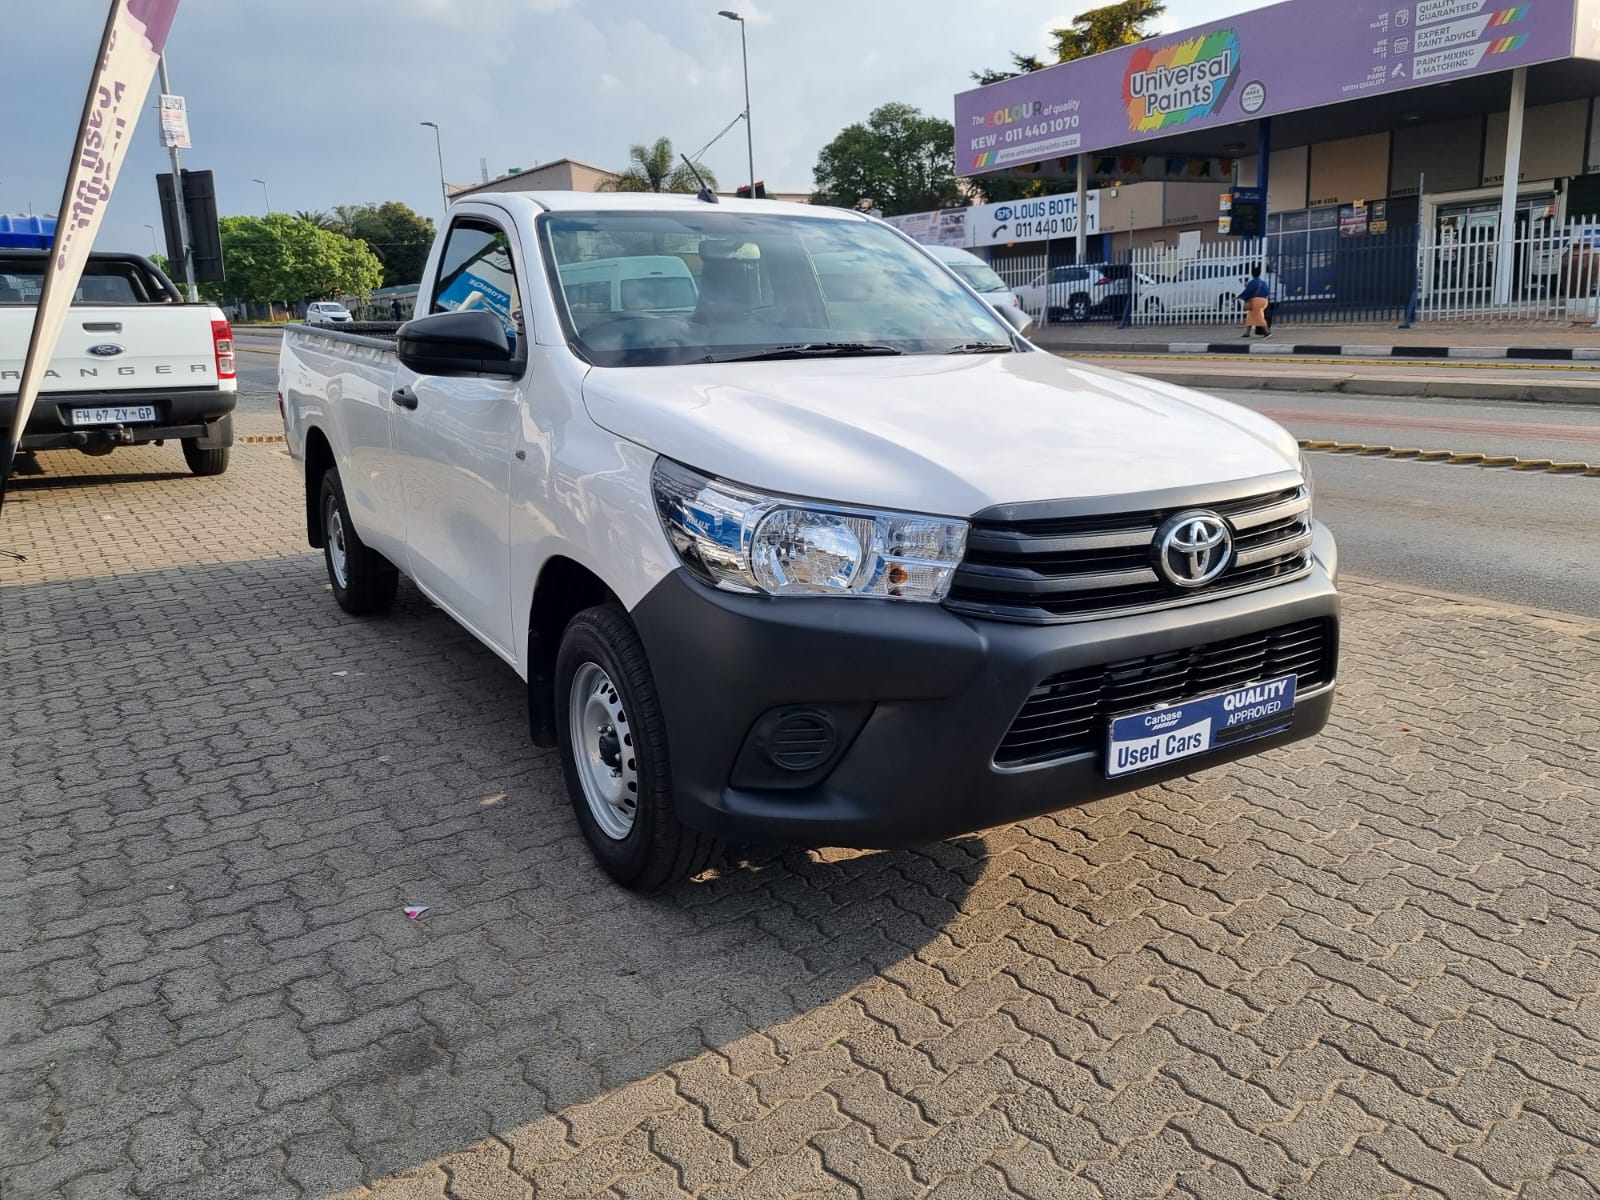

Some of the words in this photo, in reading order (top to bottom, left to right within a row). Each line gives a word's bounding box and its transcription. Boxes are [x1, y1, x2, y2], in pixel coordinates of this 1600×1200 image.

[1418, 1, 1479, 22] GUARANTEED
[1419, 0, 1456, 13] QUALITY
[1417, 26, 1451, 40] EXPERT
[1417, 37, 1444, 48] PAINT
[1444, 29, 1477, 42] ADVICE
[1416, 55, 1442, 66] PAINT
[1443, 48, 1475, 60] MIXING
[1423, 59, 1469, 75] MATCHING
[1131, 52, 1229, 96] Universal
[1147, 83, 1212, 115] Paints
[985, 100, 1043, 128] COLOUR
[1043, 104, 1053, 116] of
[1053, 99, 1081, 114] quality
[971, 133, 997, 151] KEW
[1005, 127, 1022, 143] 011
[1025, 122, 1048, 138] 440
[1050, 115, 1080, 133] 1070
[1013, 201, 1046, 220] LOUIS
[1049, 197, 1078, 216] BOTH
[1015, 221, 1032, 238] 011
[1035, 219, 1058, 236] 440
[1, 364, 208, 380] RANGER
[75, 409, 90, 423] FH
[95, 409, 109, 422] 67
[114, 407, 128, 421] ZY
[138, 407, 152, 420] GP
[1223, 679, 1288, 712] QUALITY
[1144, 709, 1183, 728] Carbase
[1226, 700, 1282, 726] APPROVED
[1117, 738, 1160, 769] Used
[1165, 732, 1202, 756] Cars
